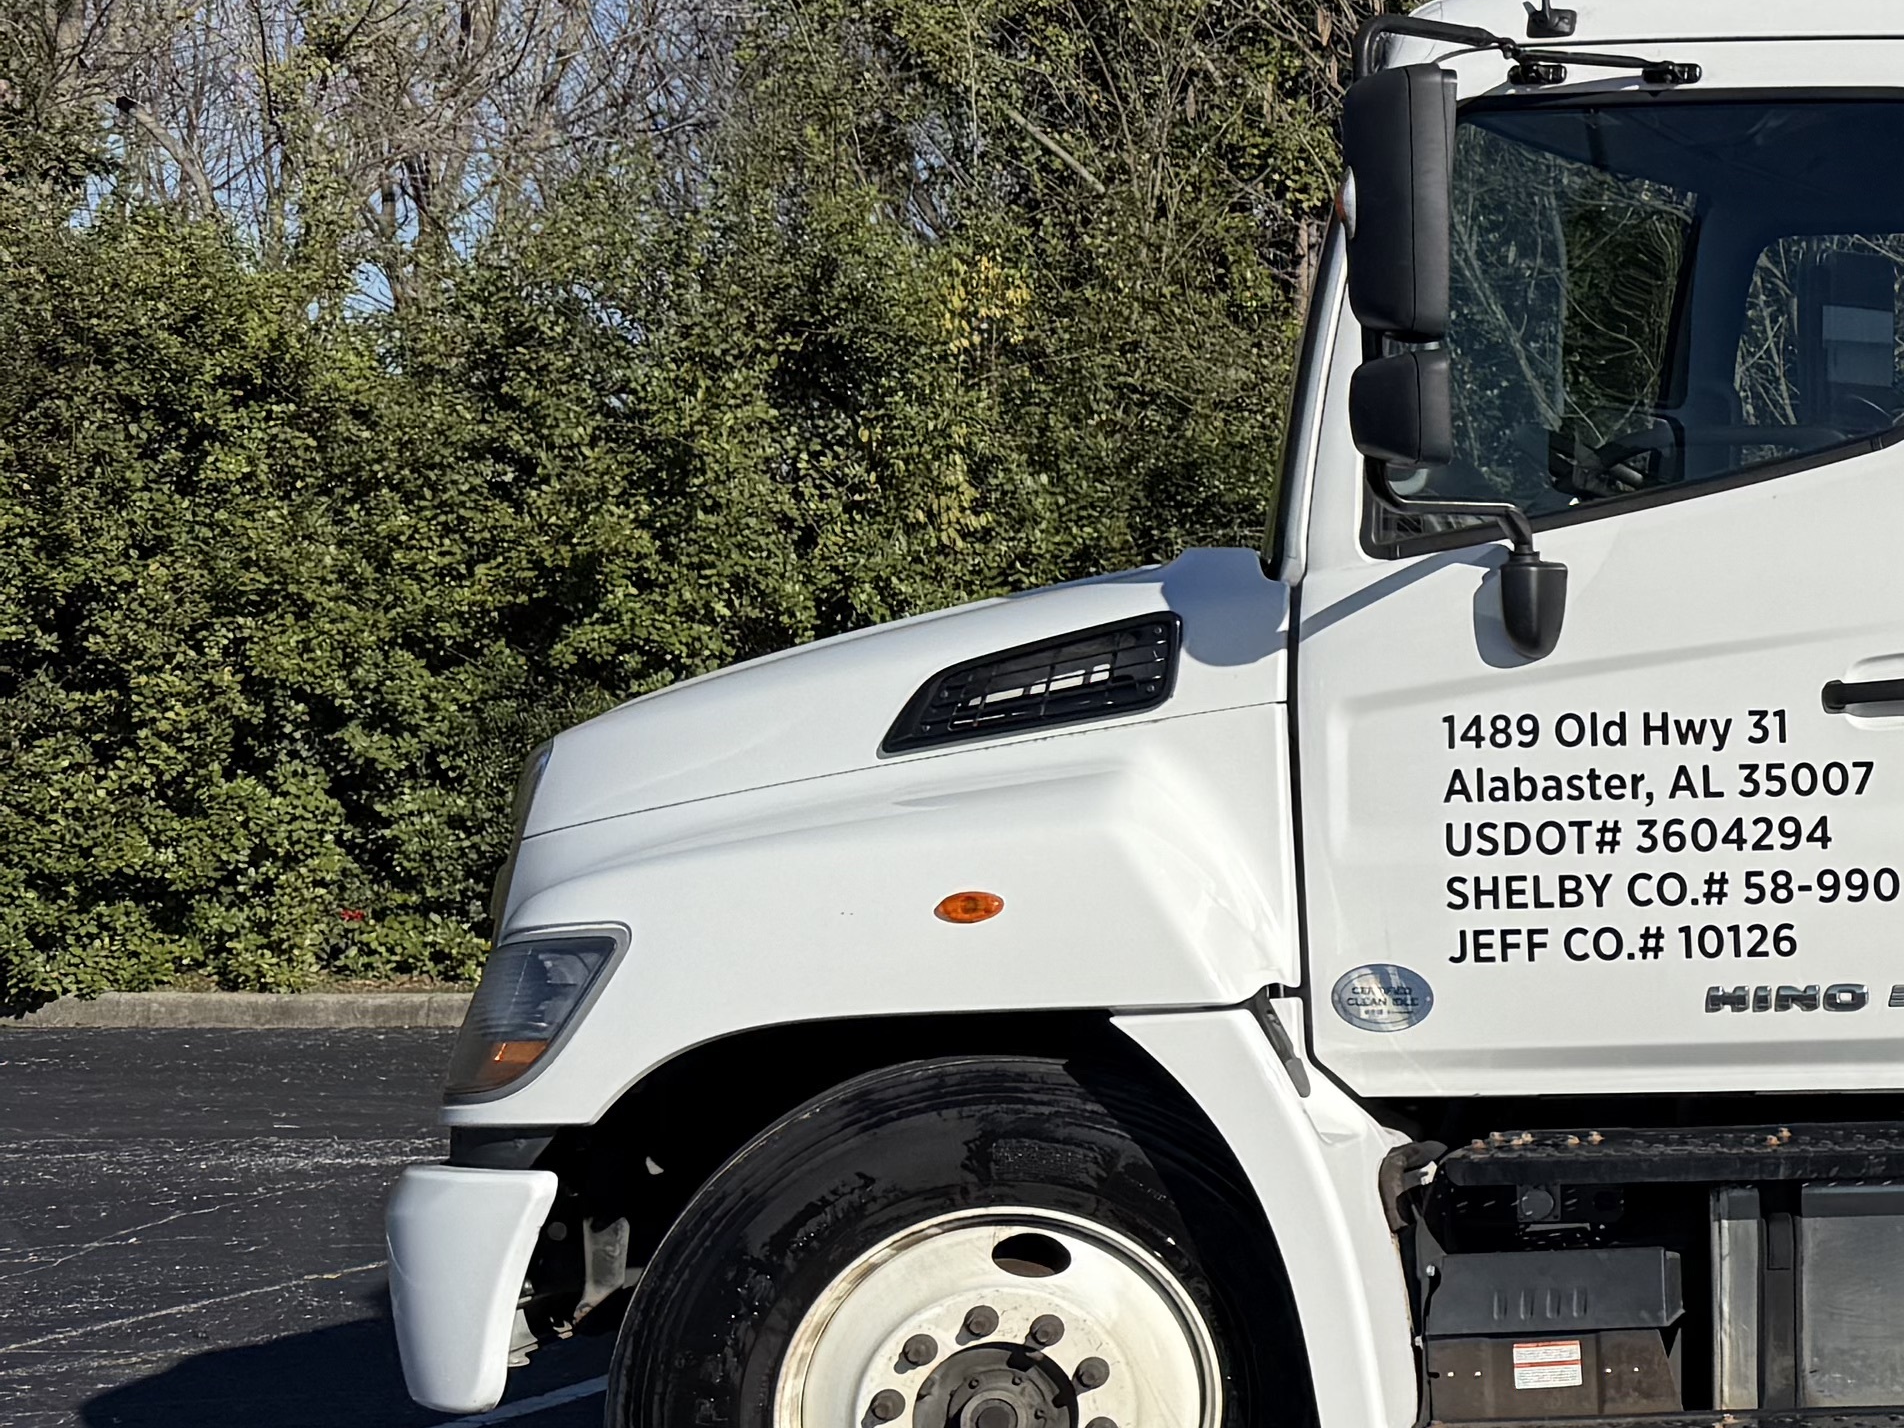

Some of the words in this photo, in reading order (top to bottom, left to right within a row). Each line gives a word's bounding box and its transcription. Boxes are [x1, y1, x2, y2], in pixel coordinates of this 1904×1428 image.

[1442, 713, 1540, 750] 1489
[1554, 711, 1627, 748] Old
[1643, 711, 1733, 752] Hwy
[1747, 709, 1787, 744] 31
[1443, 766, 1654, 807] Alabaster,
[1668, 764, 1725, 799] AL
[1738, 761, 1874, 798] 35007
[1445, 819, 1622, 857] USDOT#
[1636, 815, 1833, 854] 3604294
[1446, 873, 1613, 911] SHELBY
[1627, 871, 1729, 907] CO.#
[1744, 867, 1900, 905] 58-990
[1448, 928, 1549, 964] JEFF
[1563, 925, 1665, 962] CO.#
[1678, 922, 1797, 959] 10126
[1704, 983, 1870, 1013] HINO
